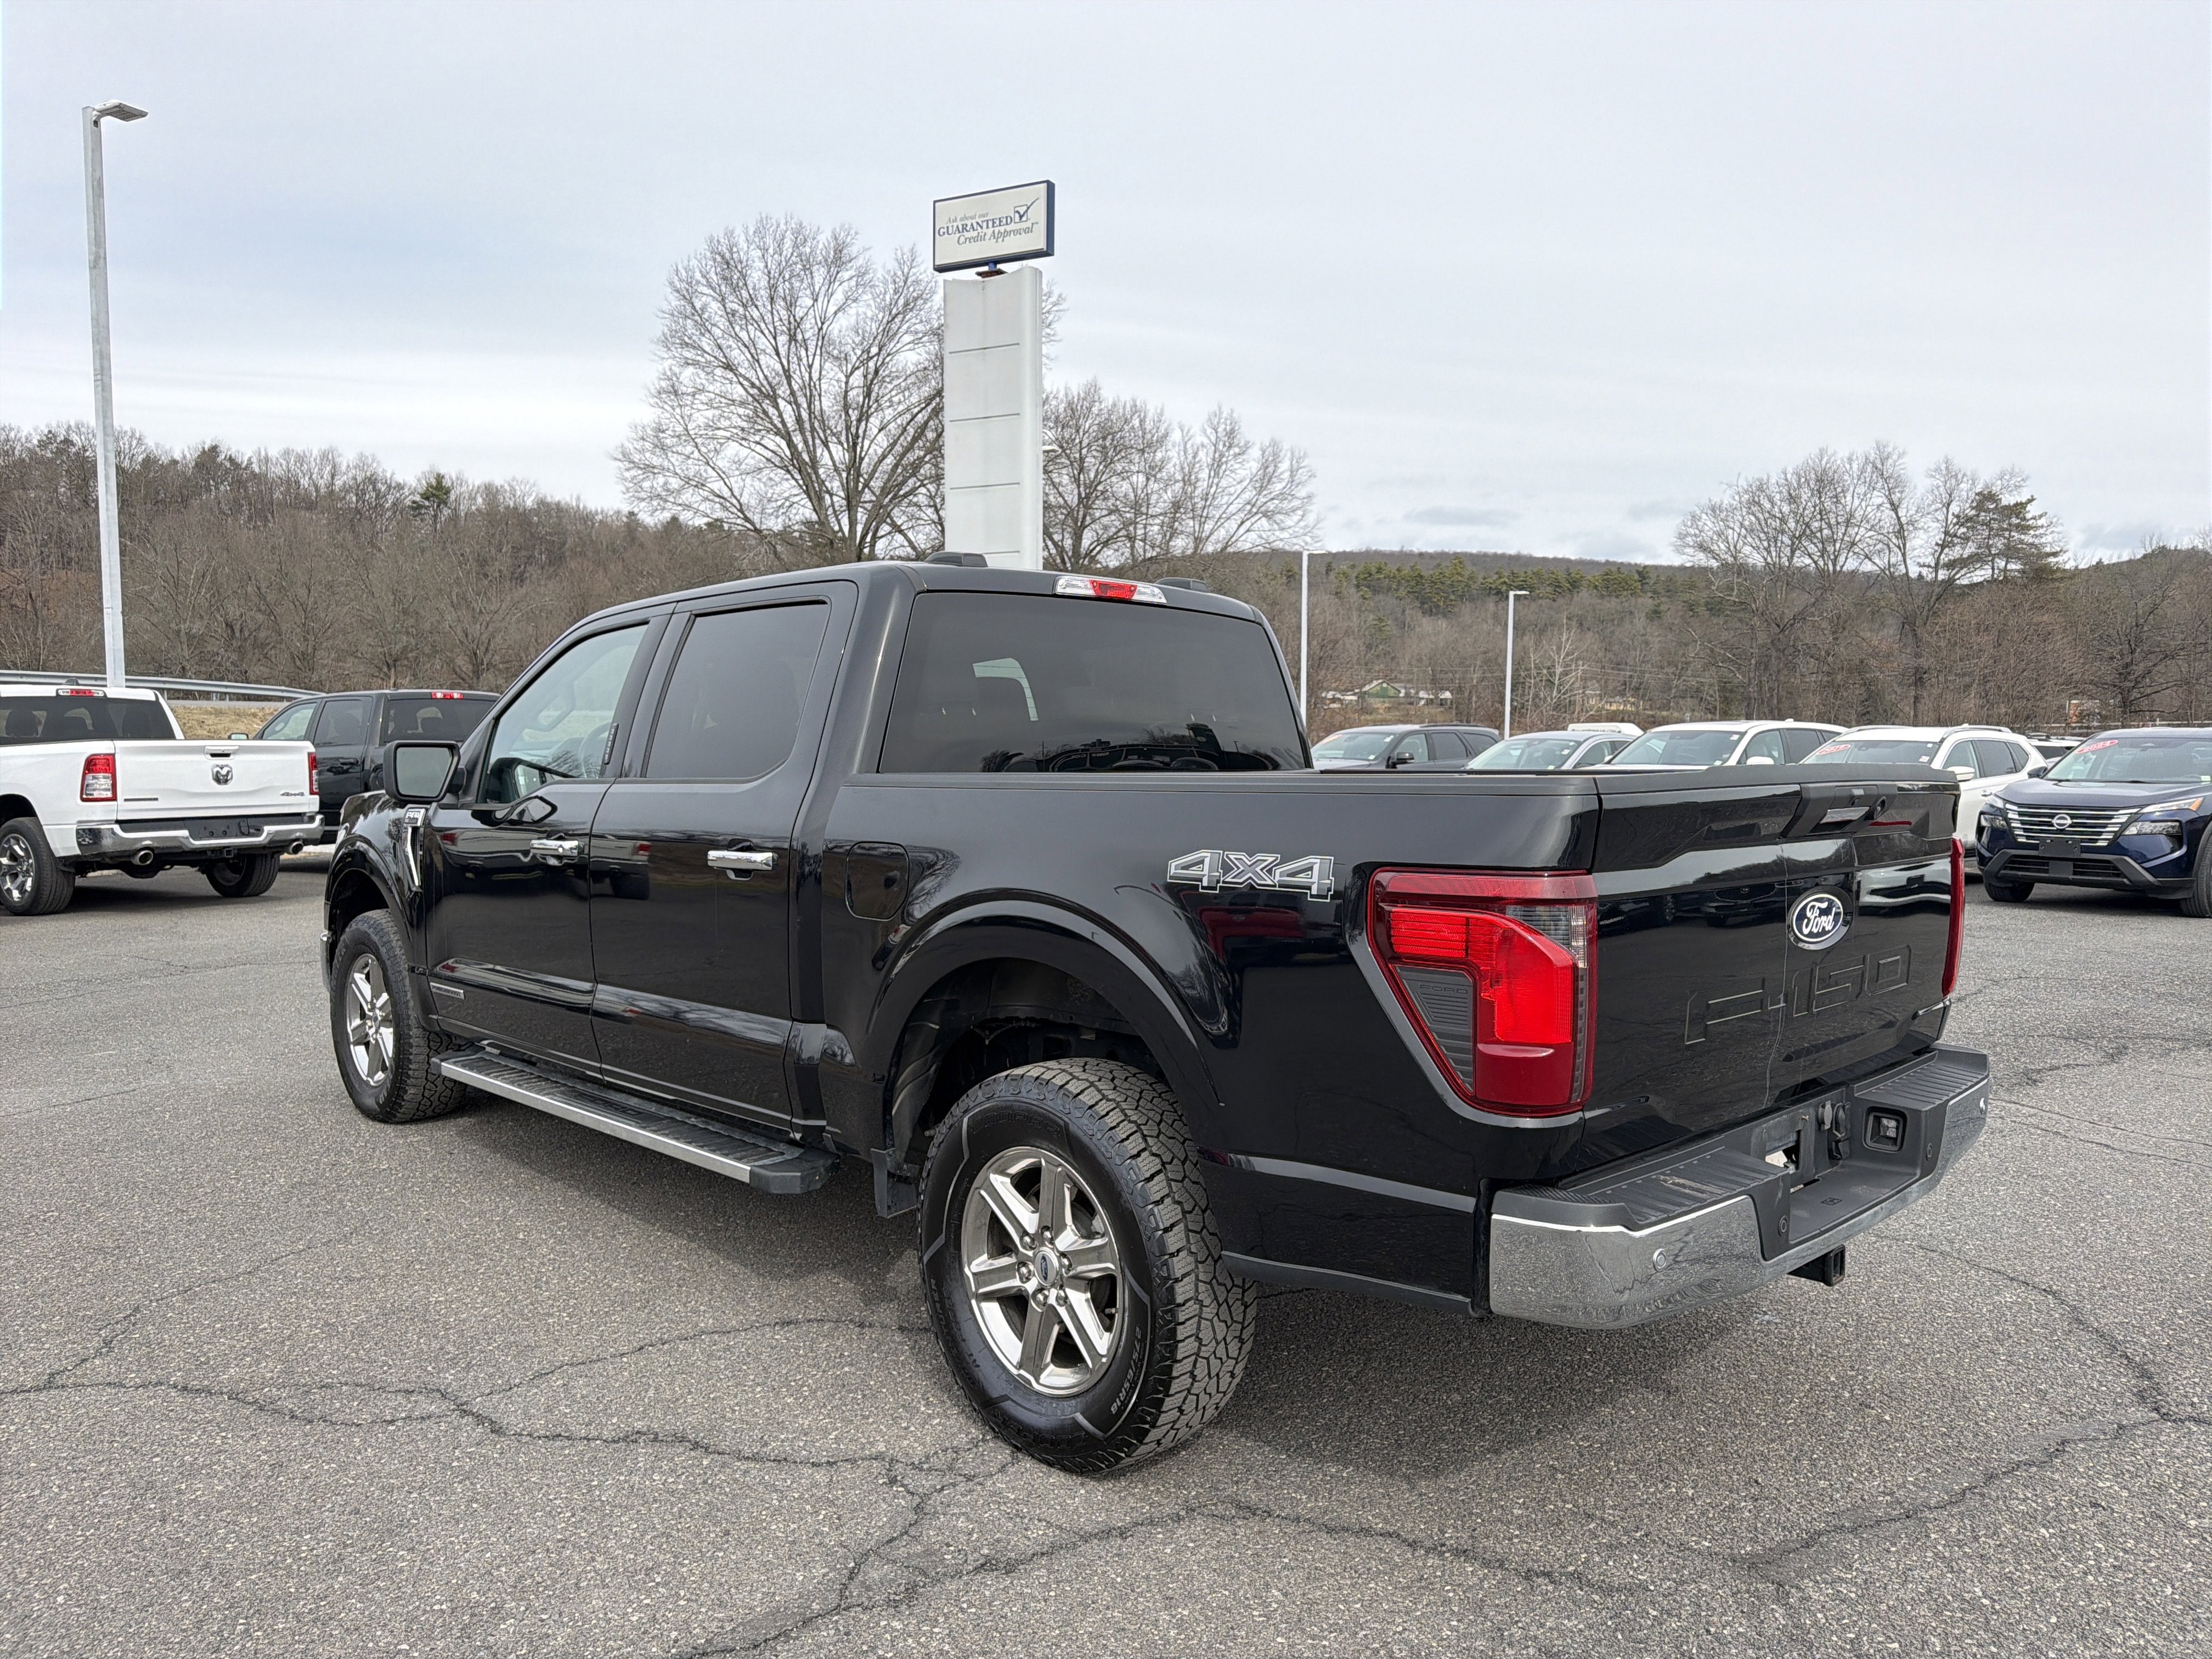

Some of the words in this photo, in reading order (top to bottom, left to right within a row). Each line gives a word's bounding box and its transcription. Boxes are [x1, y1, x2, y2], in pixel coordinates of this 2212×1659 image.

[938, 215, 1013, 237] GUARANTEED
[959, 213, 977, 222] about
[957, 233, 986, 245] Credit
[989, 223, 1034, 242] Approval
[1802, 901, 1836, 935] Ford
[1420, 984, 1468, 995] FORD
[1685, 944, 1912, 1045] F-150
[970, 1110, 1062, 1139] COOPER
[1110, 1325, 1142, 1415] 275/65R18
